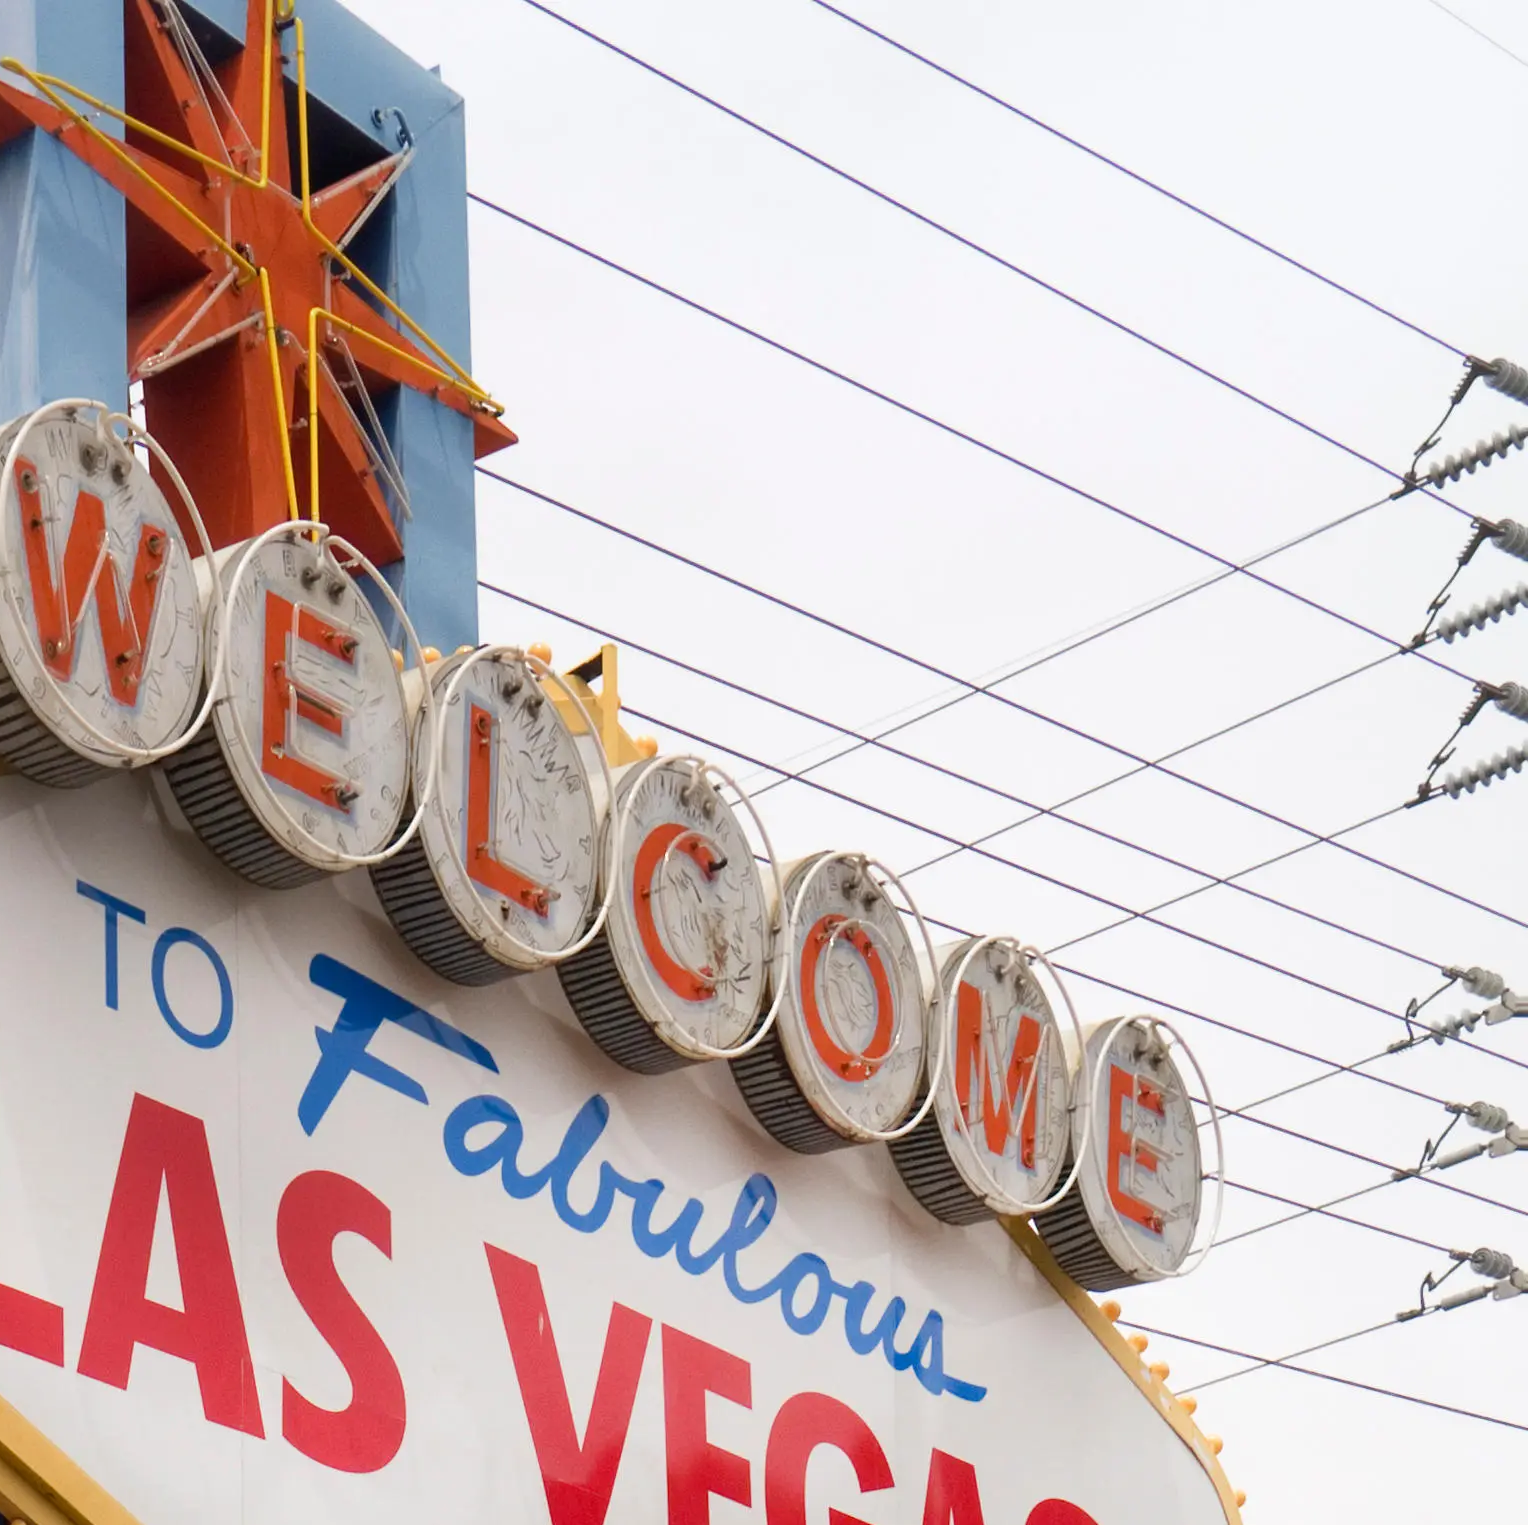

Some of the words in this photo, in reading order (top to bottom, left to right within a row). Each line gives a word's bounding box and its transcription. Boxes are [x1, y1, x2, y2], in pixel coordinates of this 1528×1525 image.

[12, 456, 1164, 1234] WELCOME
[75, 880, 234, 1050] TO
[298, 951, 988, 1404] Fabulous
